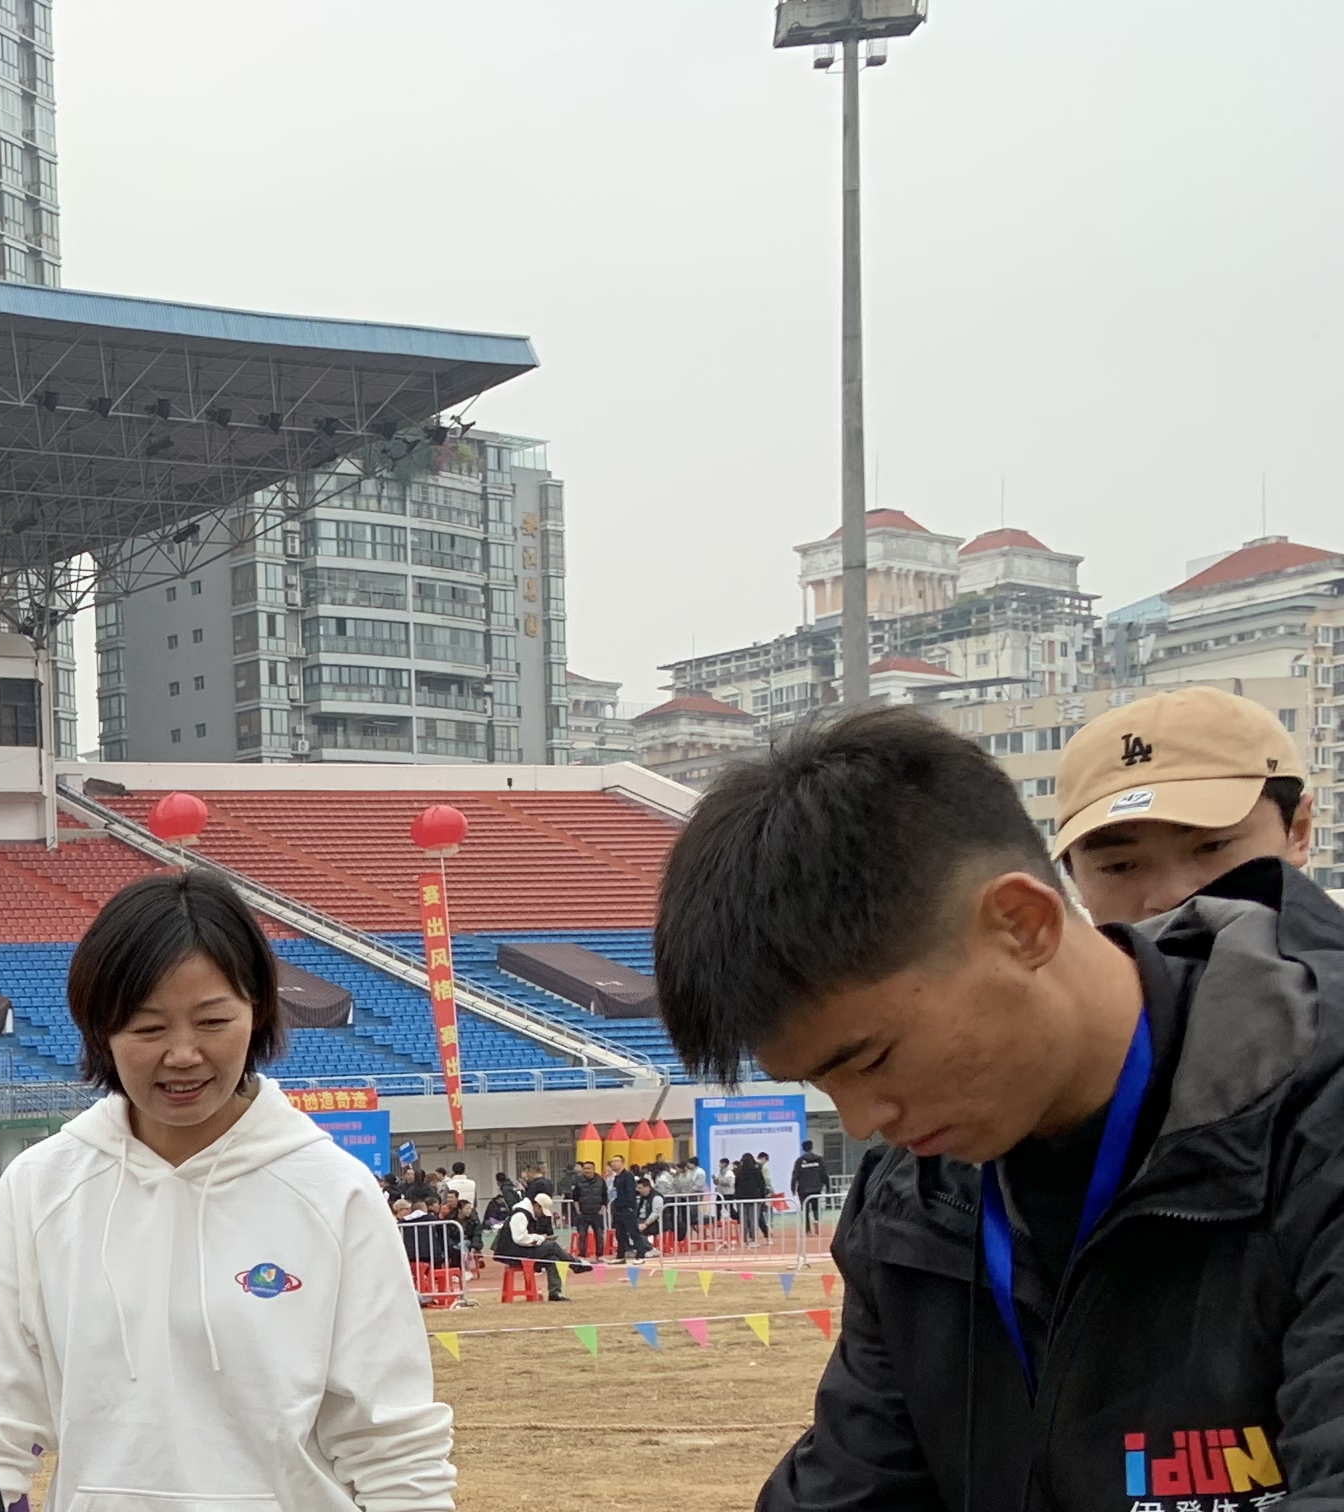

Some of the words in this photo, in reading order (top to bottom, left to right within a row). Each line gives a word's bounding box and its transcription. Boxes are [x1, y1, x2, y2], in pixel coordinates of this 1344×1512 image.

[1121, 733, 1152, 766] LA
[423, 885, 454, 1001] 赛出风格
